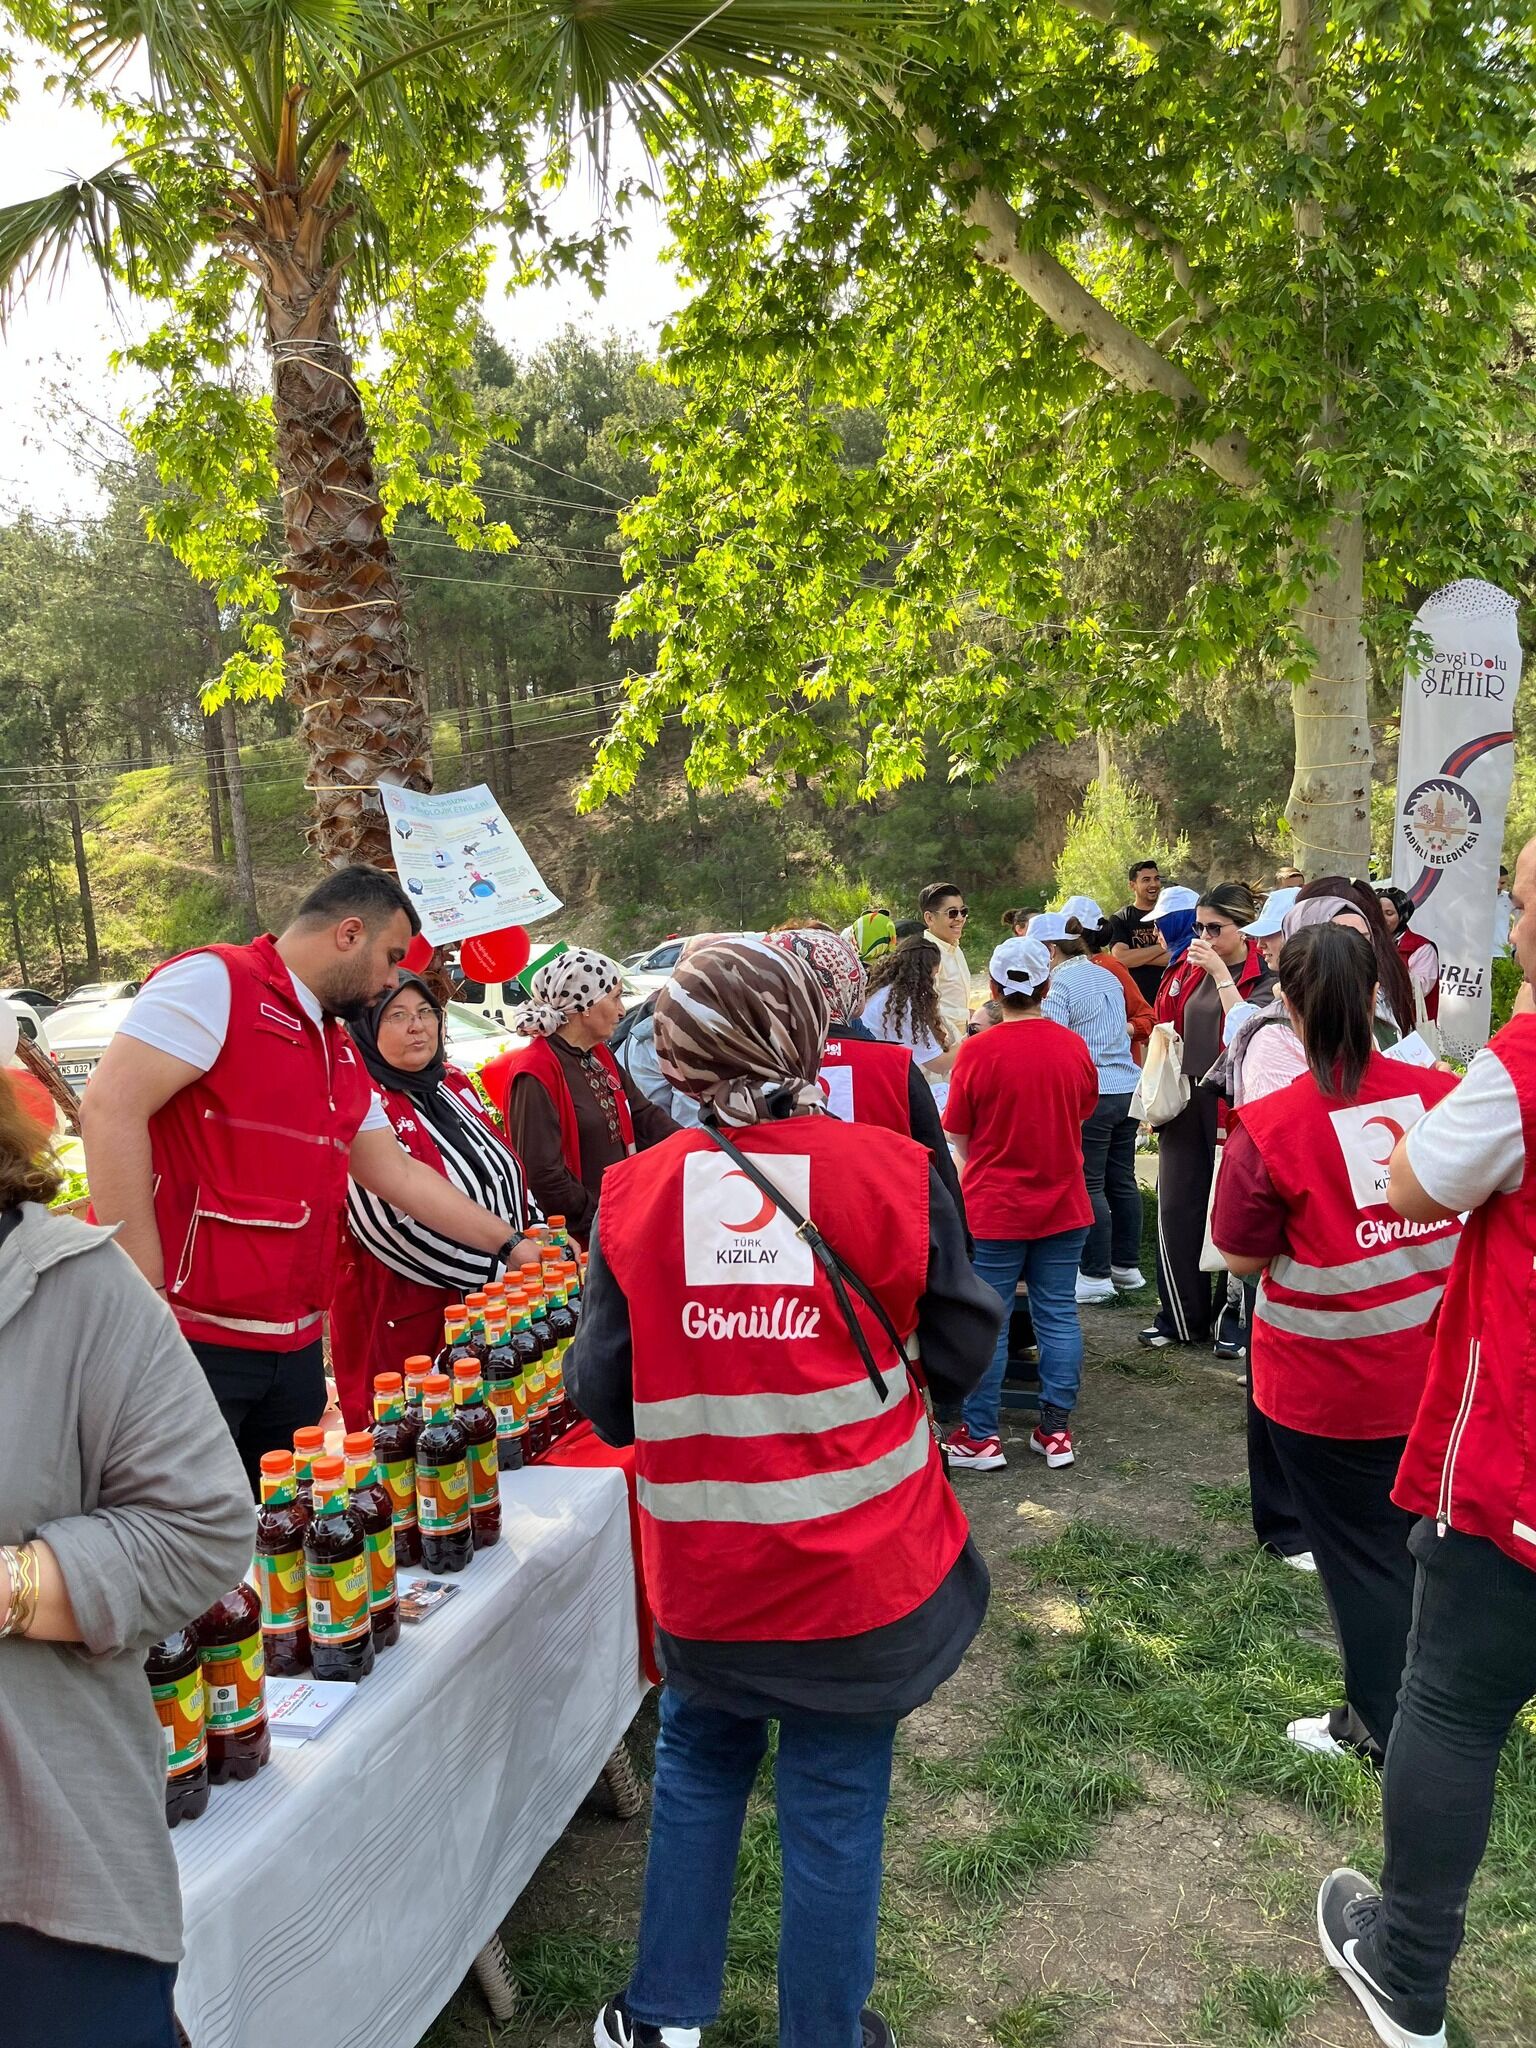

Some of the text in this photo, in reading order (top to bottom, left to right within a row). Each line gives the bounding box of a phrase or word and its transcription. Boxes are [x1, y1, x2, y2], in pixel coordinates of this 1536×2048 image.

[1421, 667, 1505, 701] ŞEHİR
[1403, 824, 1479, 864] KADİRLİ BELEDİYESİ
[1440, 964, 1484, 985] İRLİ
[74, 1065, 88, 1073] 032
[734, 1237, 762, 1247] TÜRK
[716, 1250, 779, 1264] KIZILAY
[682, 1297, 821, 1341] Gönüllü
